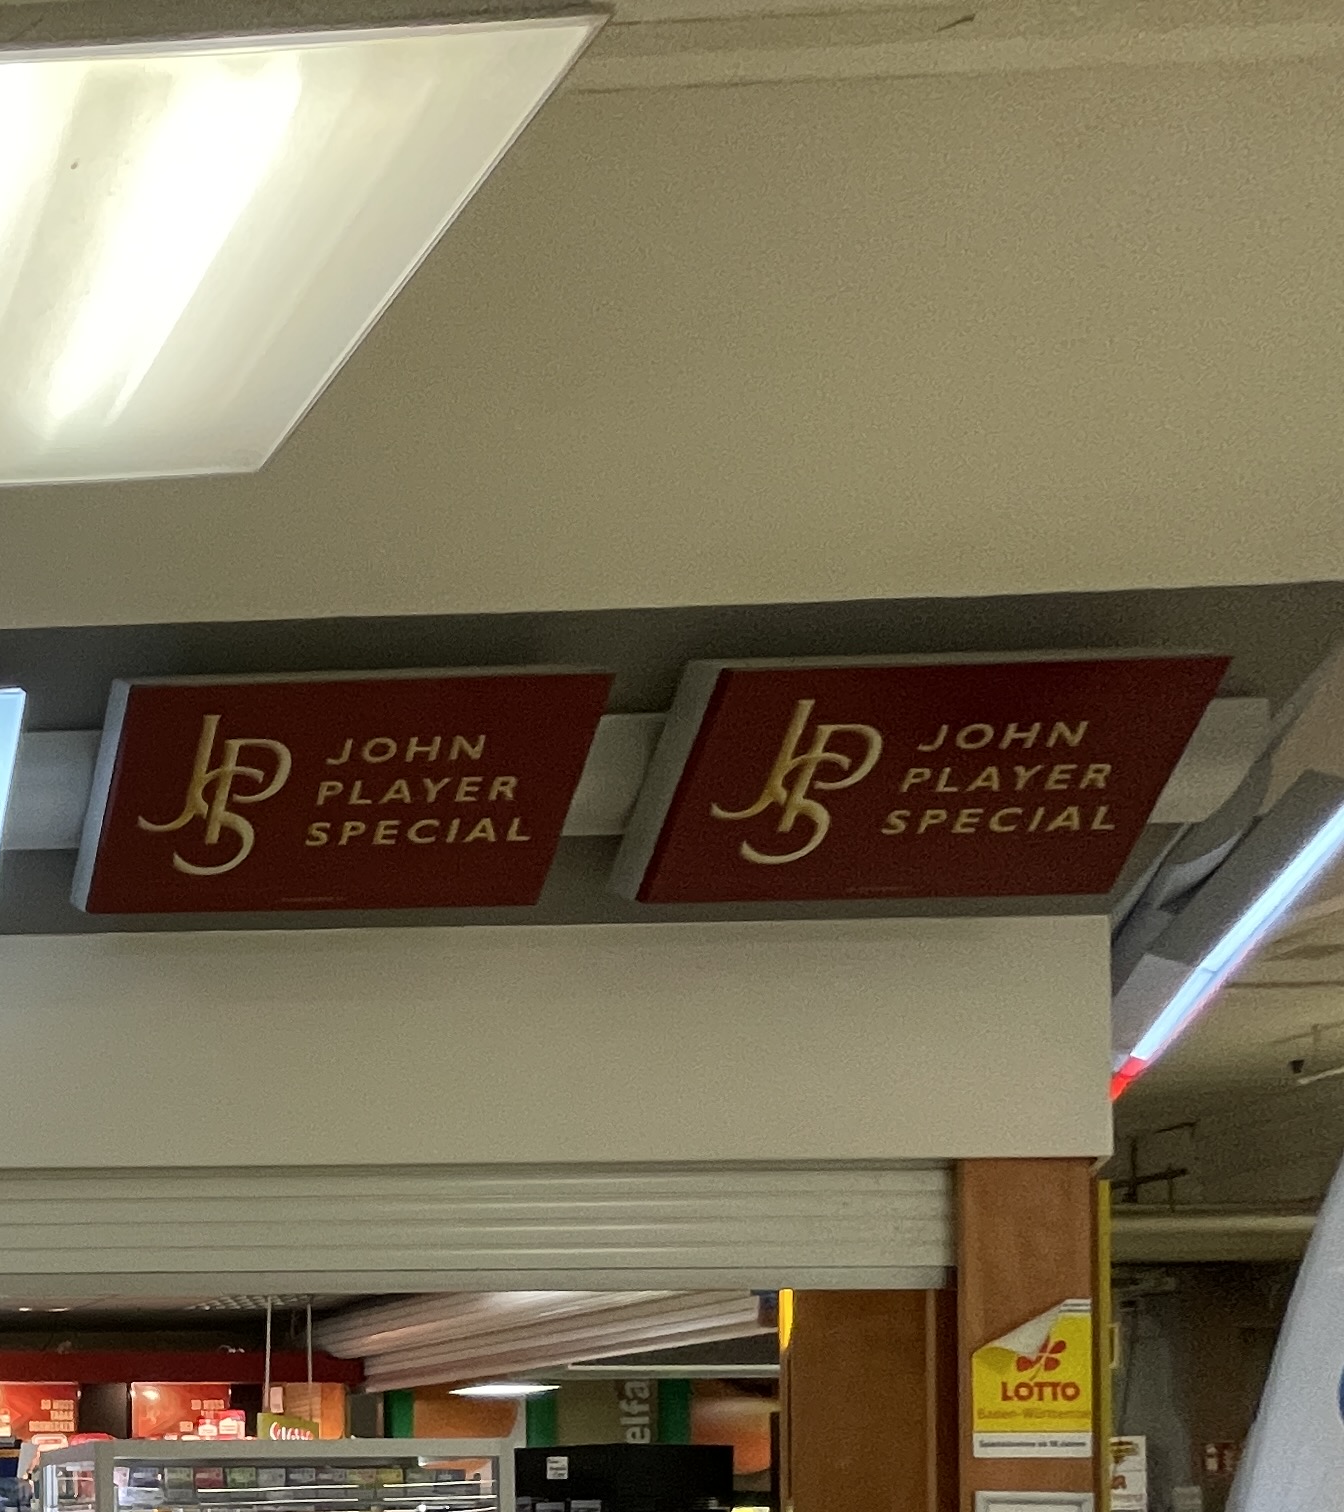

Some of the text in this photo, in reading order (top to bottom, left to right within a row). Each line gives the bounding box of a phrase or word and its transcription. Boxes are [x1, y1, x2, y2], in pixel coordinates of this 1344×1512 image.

[325, 734, 487, 765] JOHN
[916, 720, 1090, 752] JOHN
[315, 775, 519, 806] PLAYER
[899, 762, 1113, 794] PLAYER
[304, 816, 532, 846] SPECIAL
[881, 804, 1117, 836] SPECIAL
[1001, 1381, 1081, 1402] LOTTO
